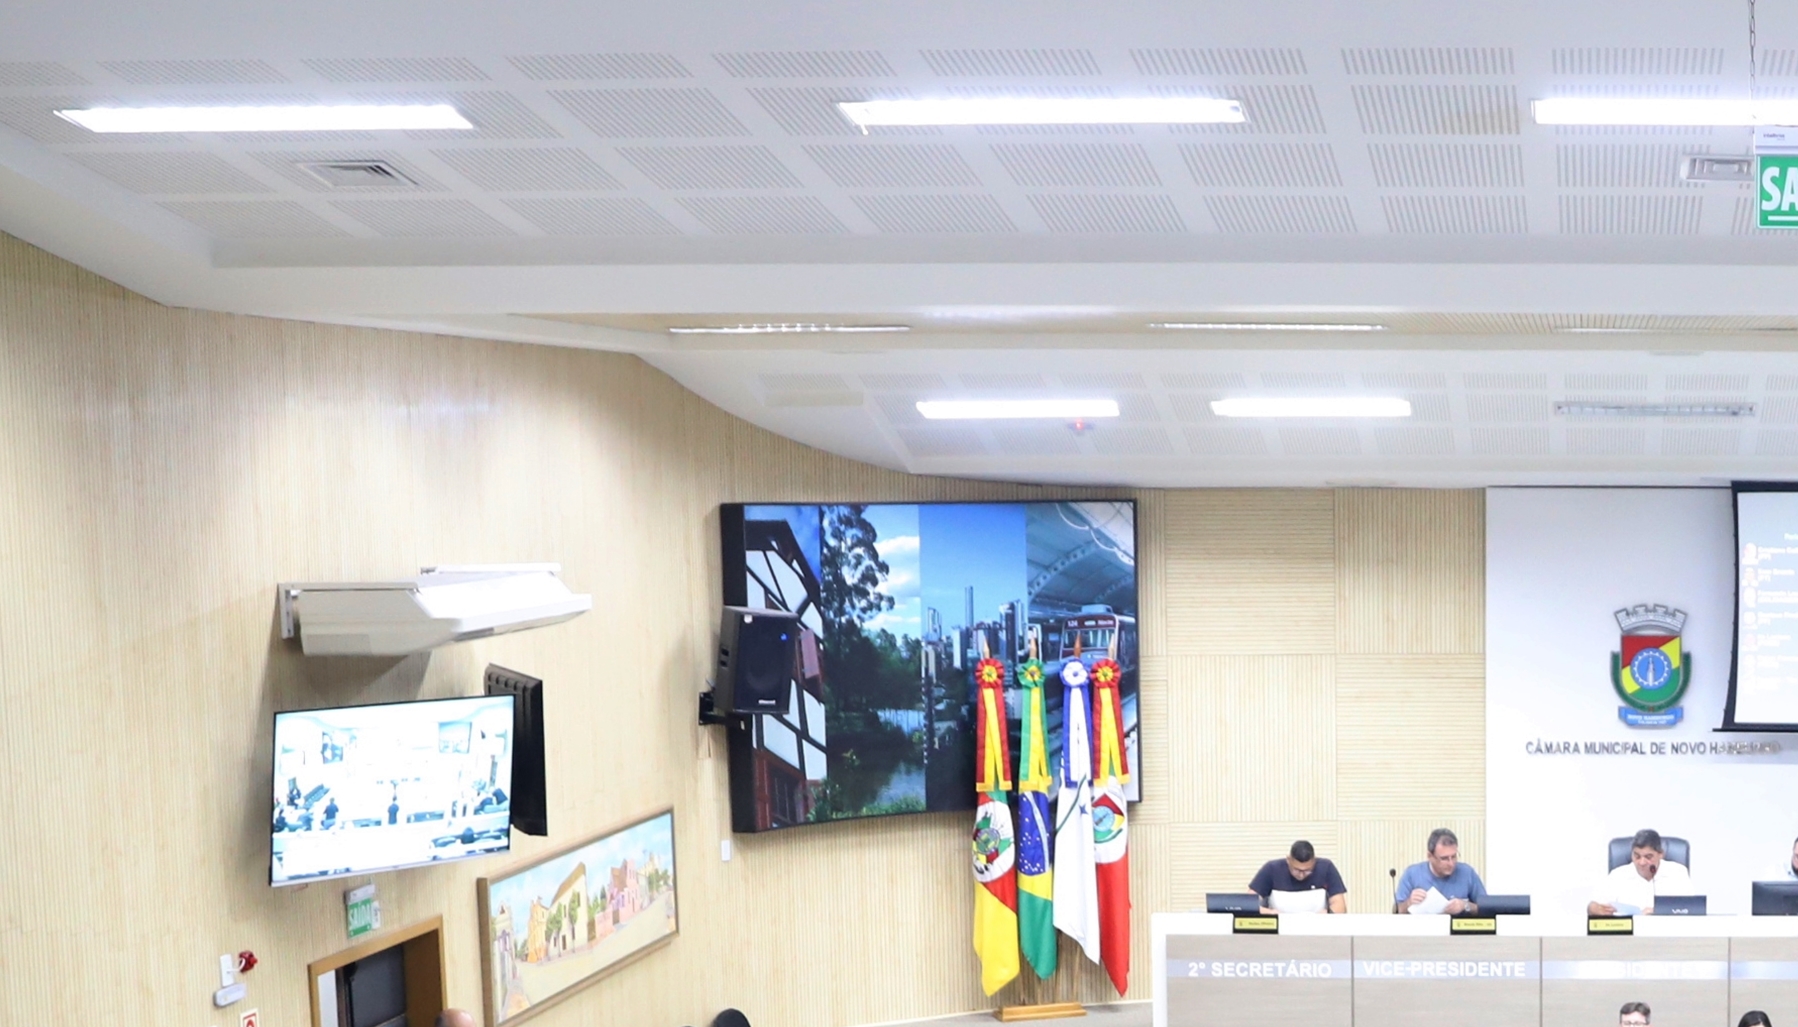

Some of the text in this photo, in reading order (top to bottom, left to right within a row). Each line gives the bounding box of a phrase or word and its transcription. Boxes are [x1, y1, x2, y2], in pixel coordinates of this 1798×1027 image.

[1526, 738, 1580, 755] CÂMARA
[1584, 741, 1646, 755] MUNICIPAL
[1650, 741, 1665, 755] DE
[1671, 741, 1706, 755] NOVO
[1188, 959, 1332, 977] 2º SECRETÁRIO
[1362, 961, 1526, 977] VICE-PRESIDENTE
